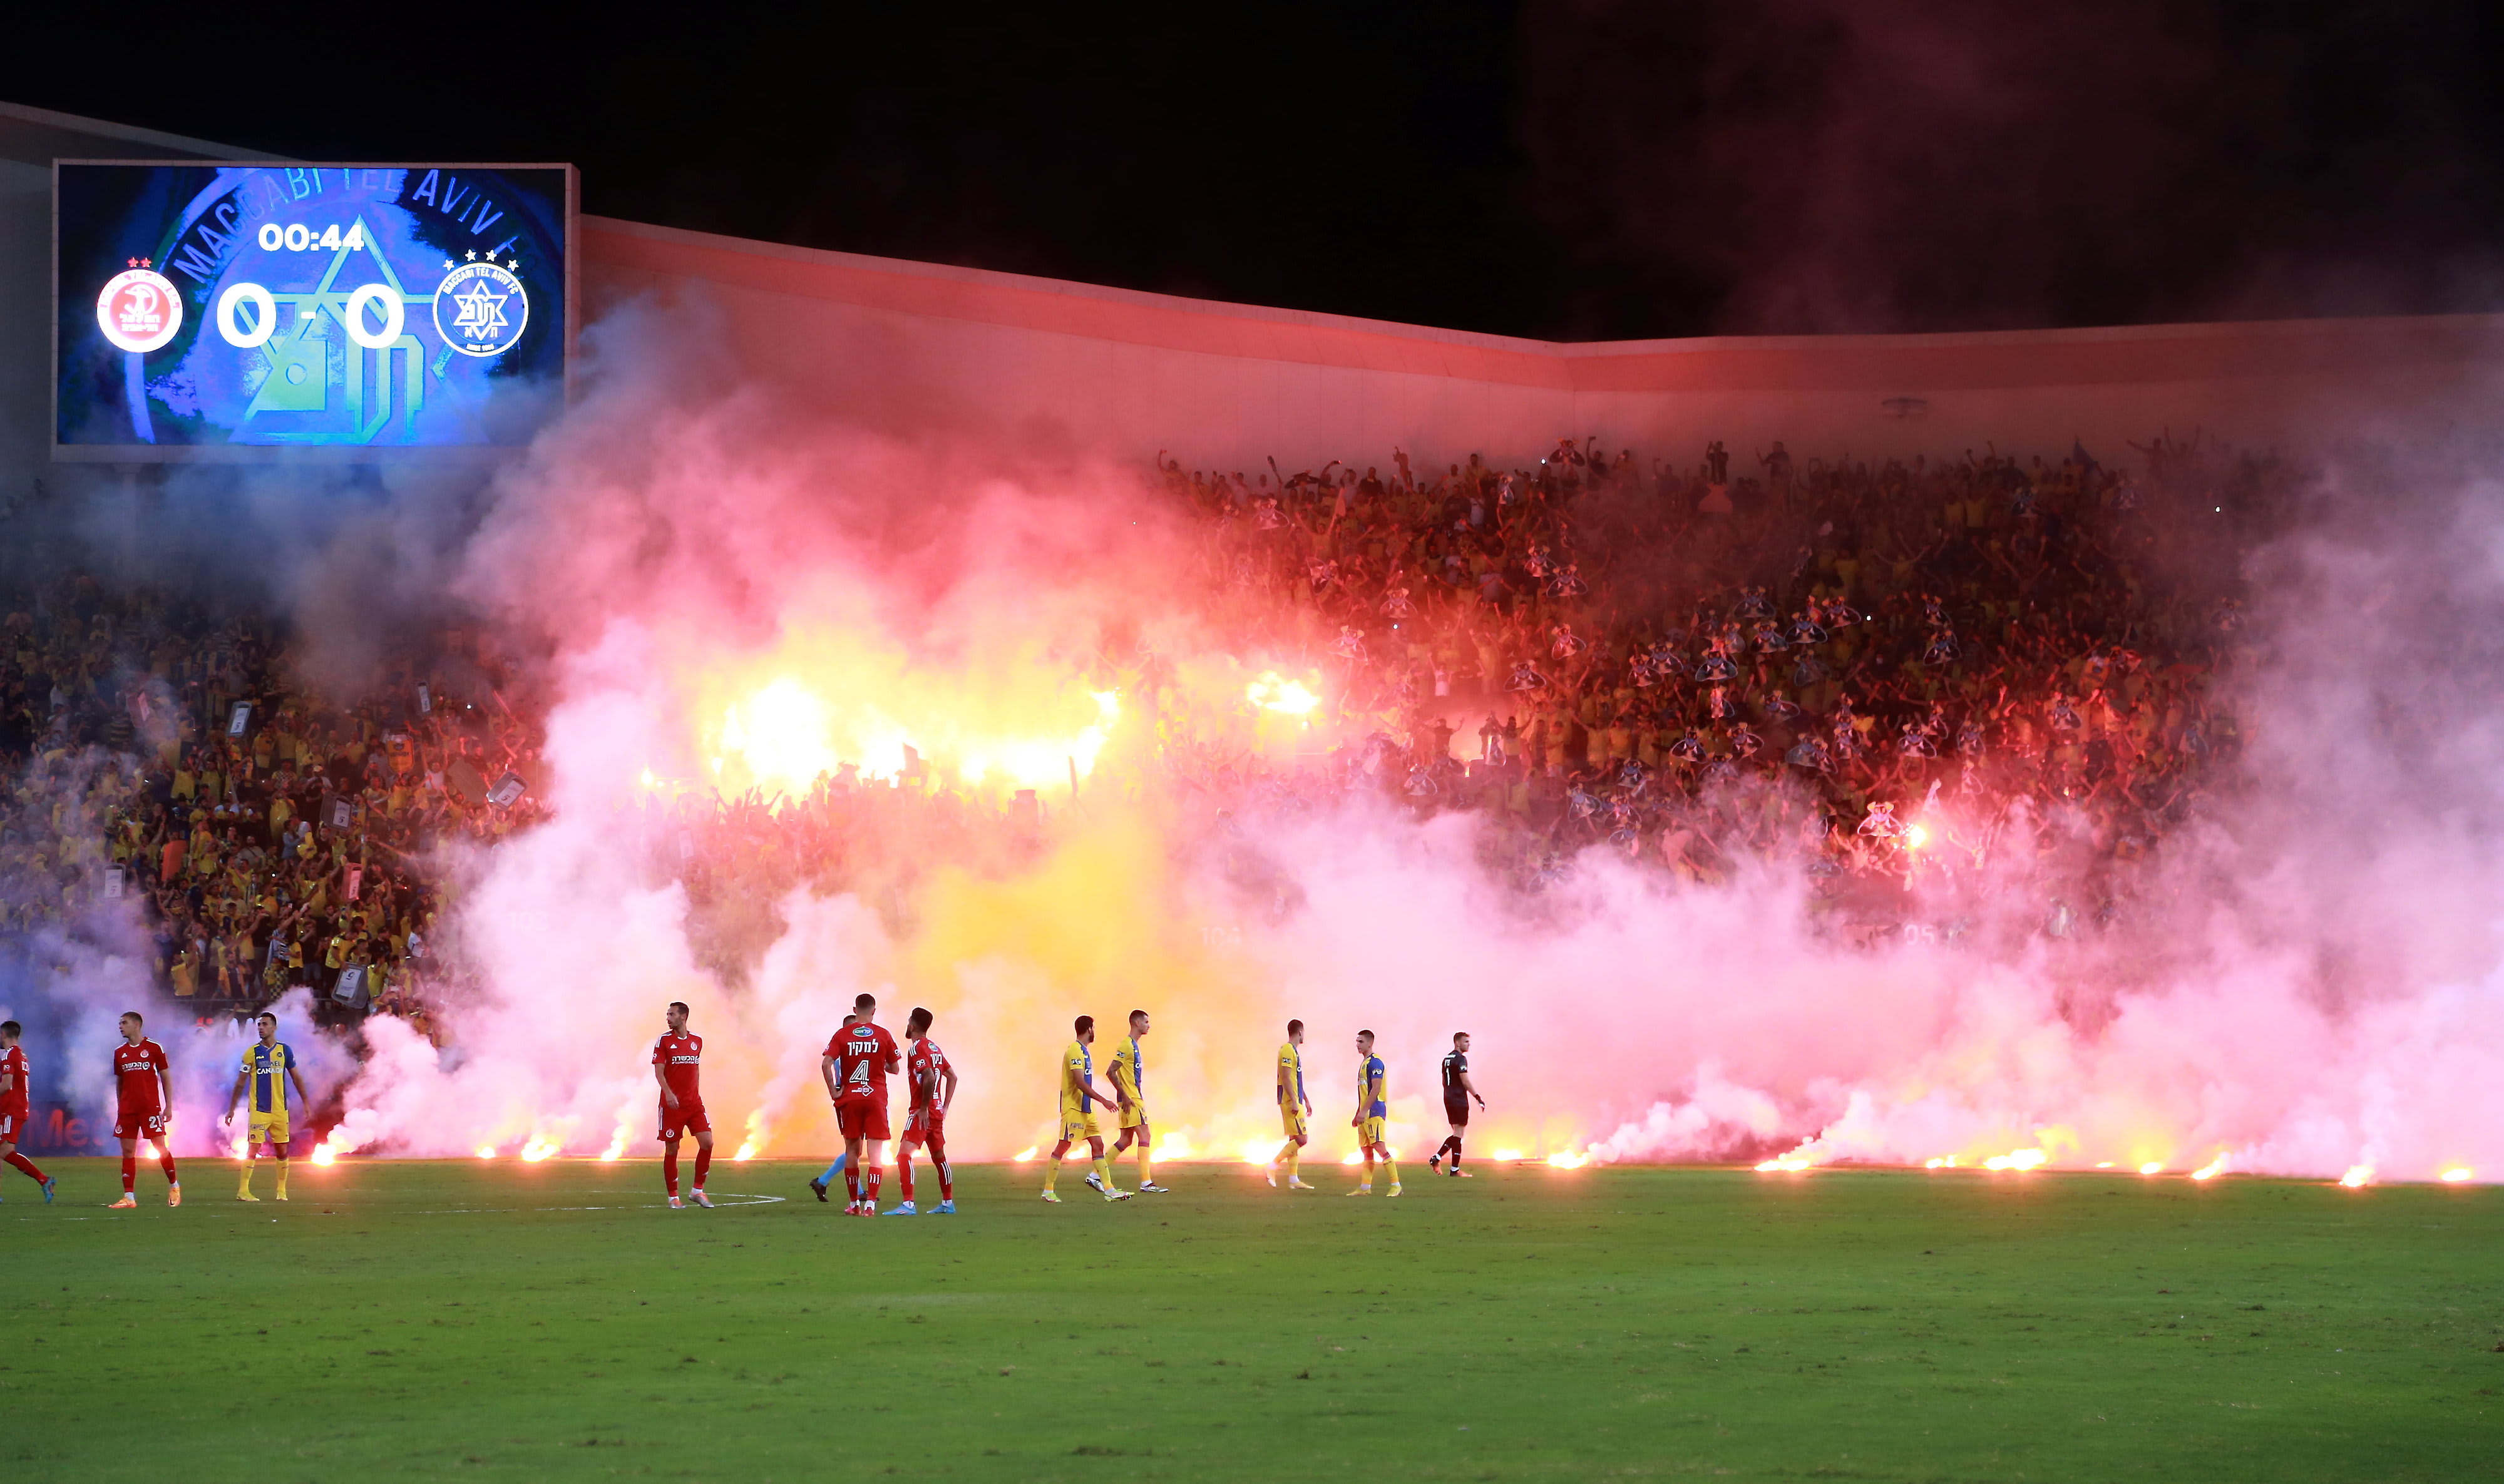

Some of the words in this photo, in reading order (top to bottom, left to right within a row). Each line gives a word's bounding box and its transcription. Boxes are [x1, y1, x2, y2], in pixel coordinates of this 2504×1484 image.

[413, 169, 503, 235] AVIV
[259, 223, 365, 251] 00:44
[442, 268, 475, 295] MACCABI
[476, 267, 490, 277] TEL
[491, 270, 511, 285] AVIV
[507, 283, 519, 295] FC
[217, 282, 277, 348] 0
[346, 283, 404, 349] 0
[849, 1060, 870, 1083] 4
[148, 1115, 162, 1128] 21
